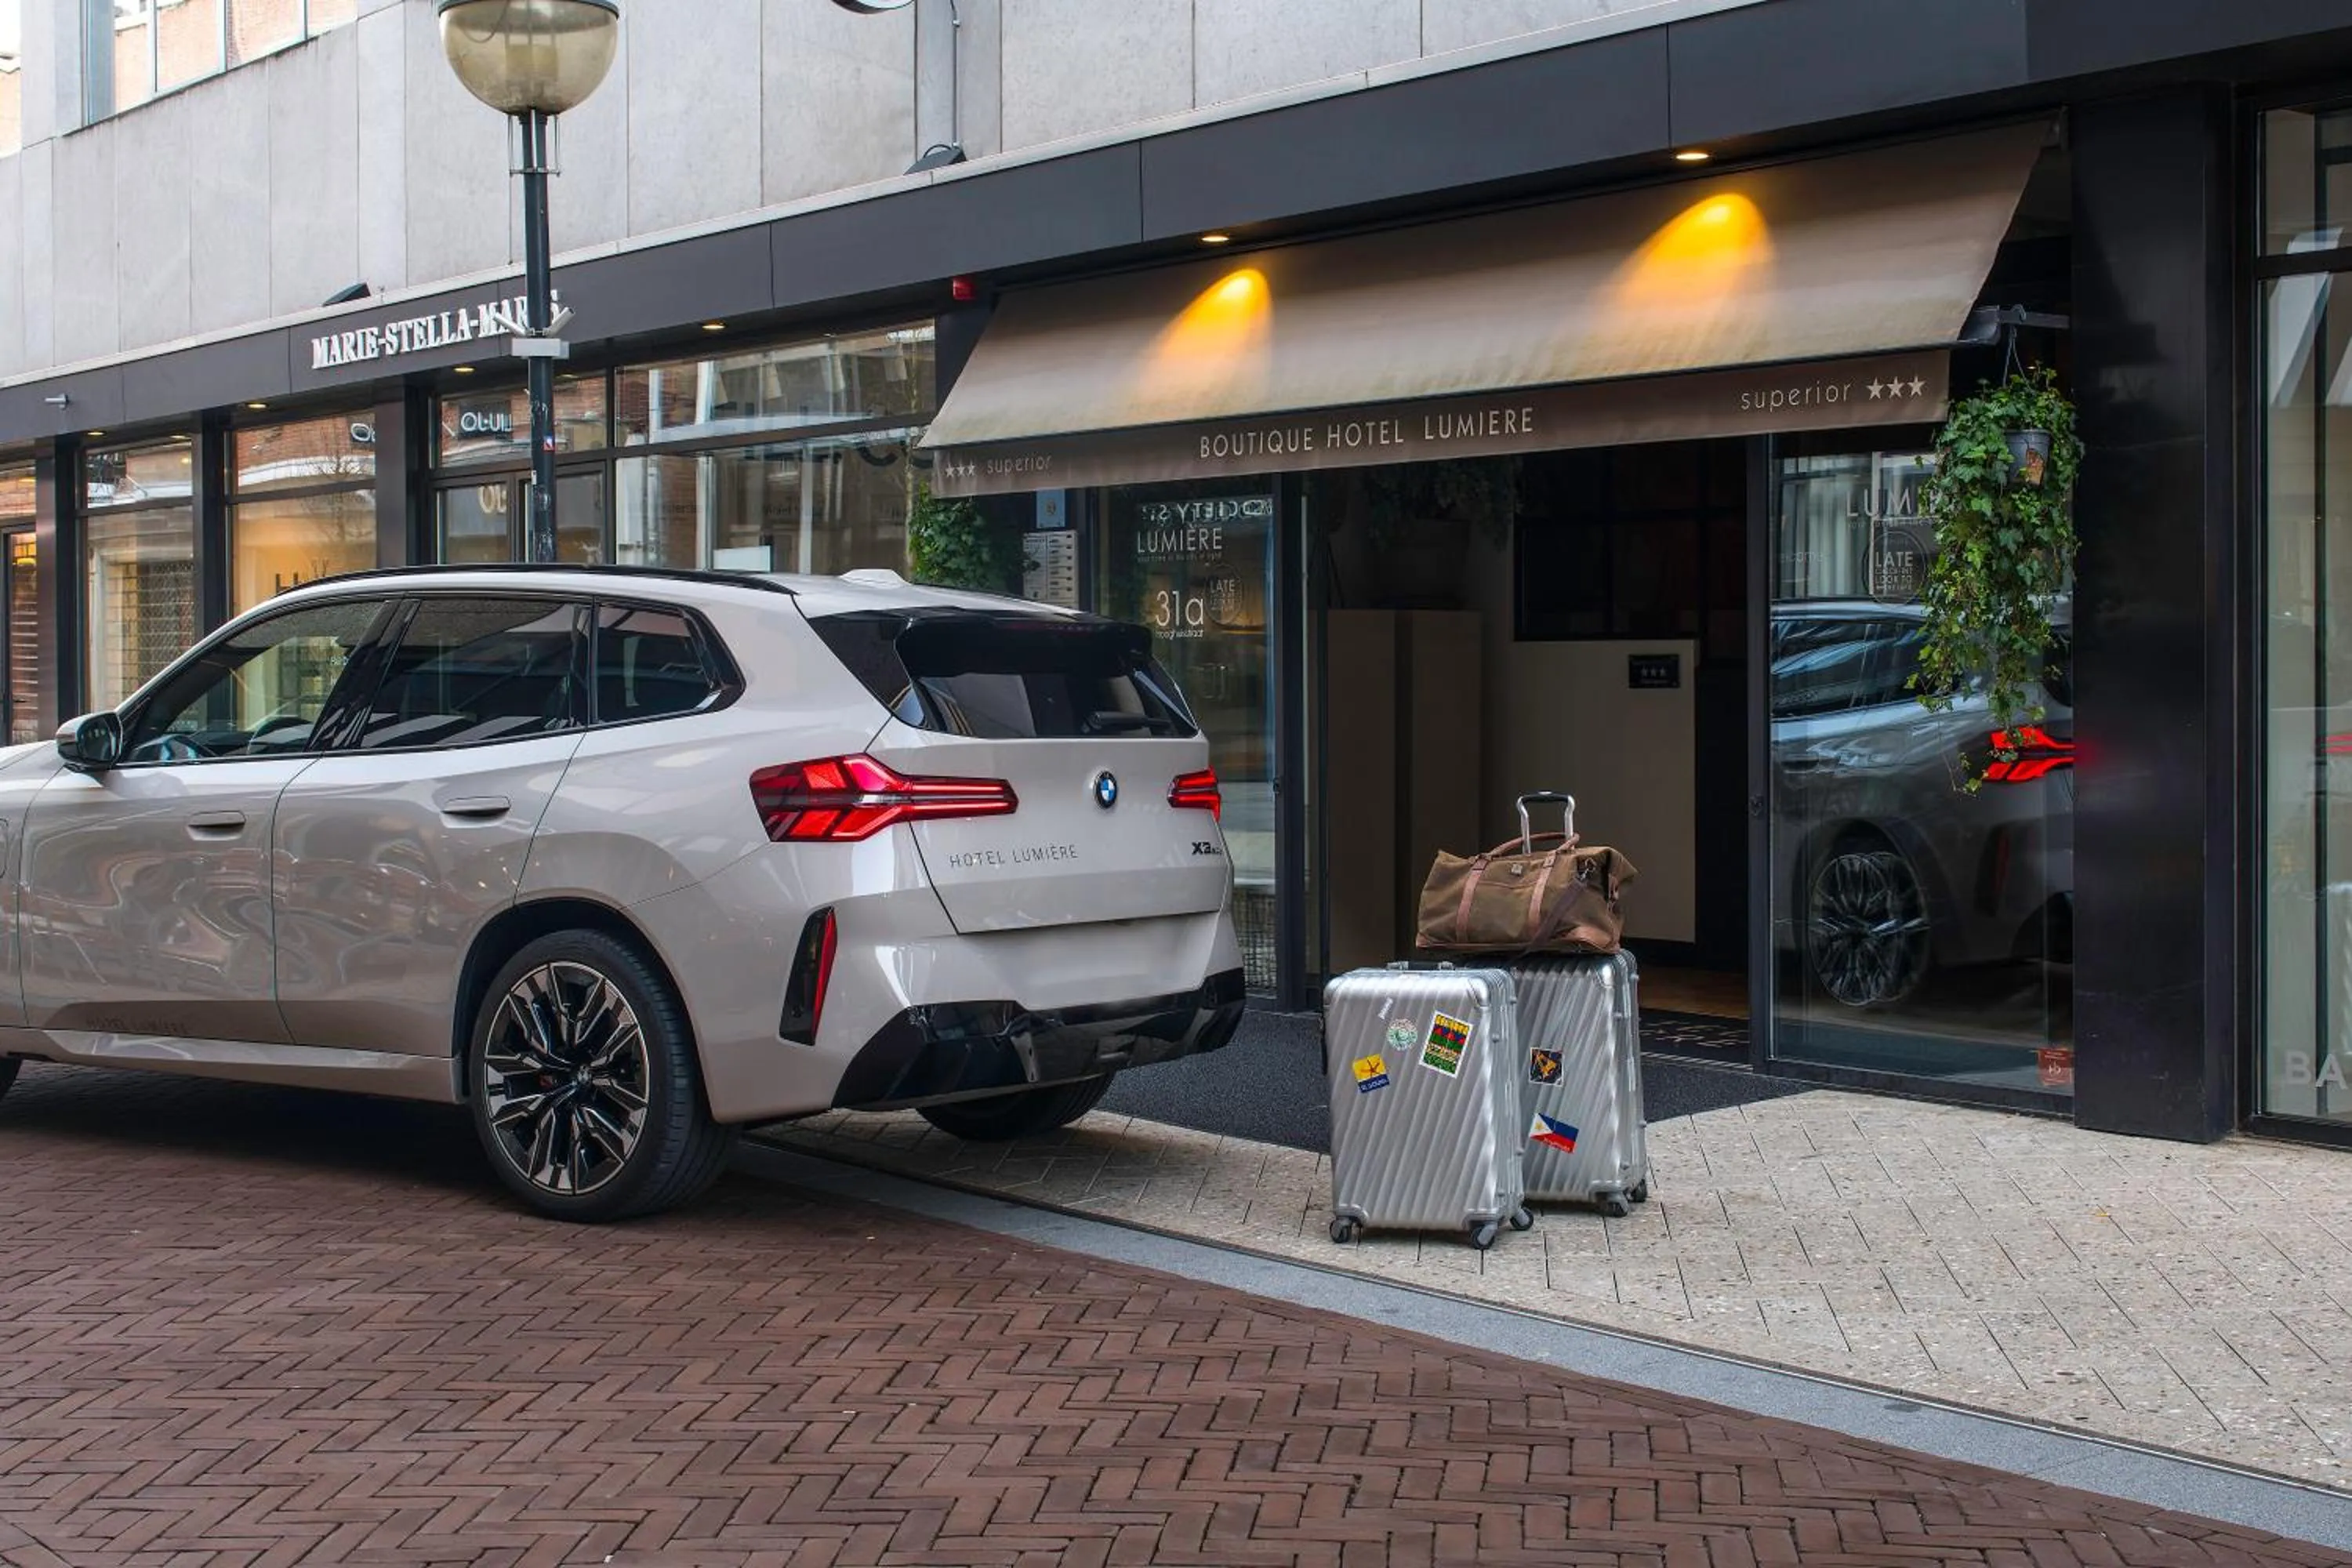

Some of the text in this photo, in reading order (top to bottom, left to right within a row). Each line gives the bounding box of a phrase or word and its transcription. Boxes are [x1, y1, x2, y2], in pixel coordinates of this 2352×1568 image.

[311, 289, 560, 368] MARIE-STELLA-MARS
[1740, 380, 1852, 412] superior
[1200, 407, 1534, 458] BOUTIQUE HOTEL LUMIERE
[986, 455, 1051, 476] superior
[1137, 523, 1222, 554] LUMIÈRE
[1875, 551, 1914, 568] LATE
[1155, 590, 1204, 626] 31a
[949, 851, 1005, 868] HOTEL
